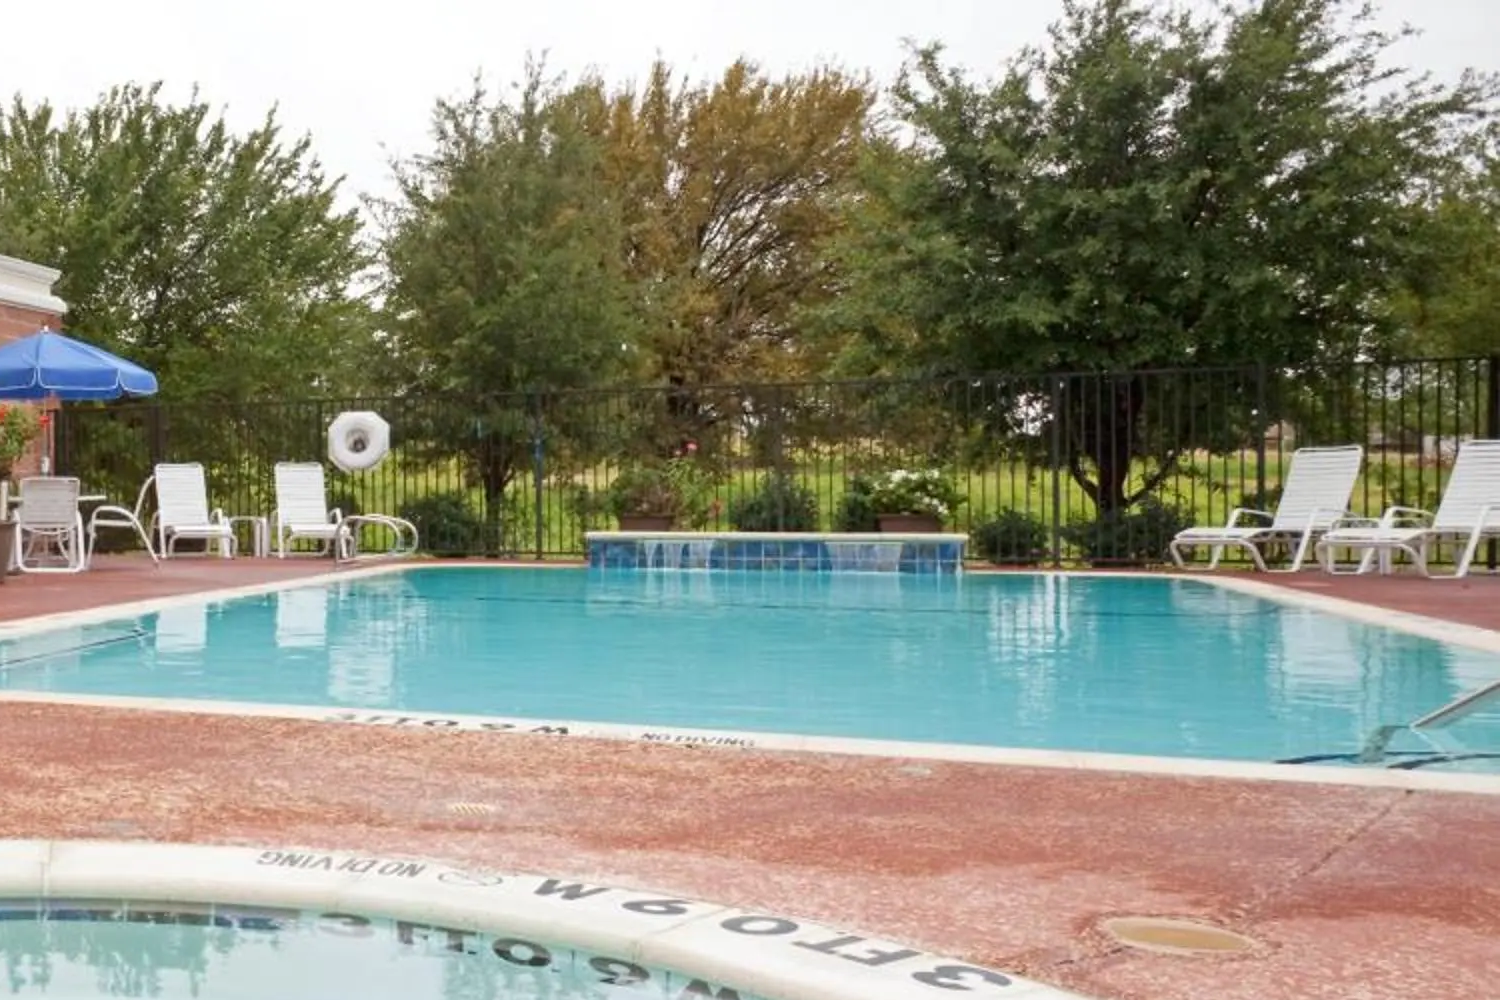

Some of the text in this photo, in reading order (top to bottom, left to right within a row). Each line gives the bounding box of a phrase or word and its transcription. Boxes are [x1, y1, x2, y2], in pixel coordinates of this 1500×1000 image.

[256, 850, 427, 878] NO DIVING
[911, 964, 1014, 992] 3
